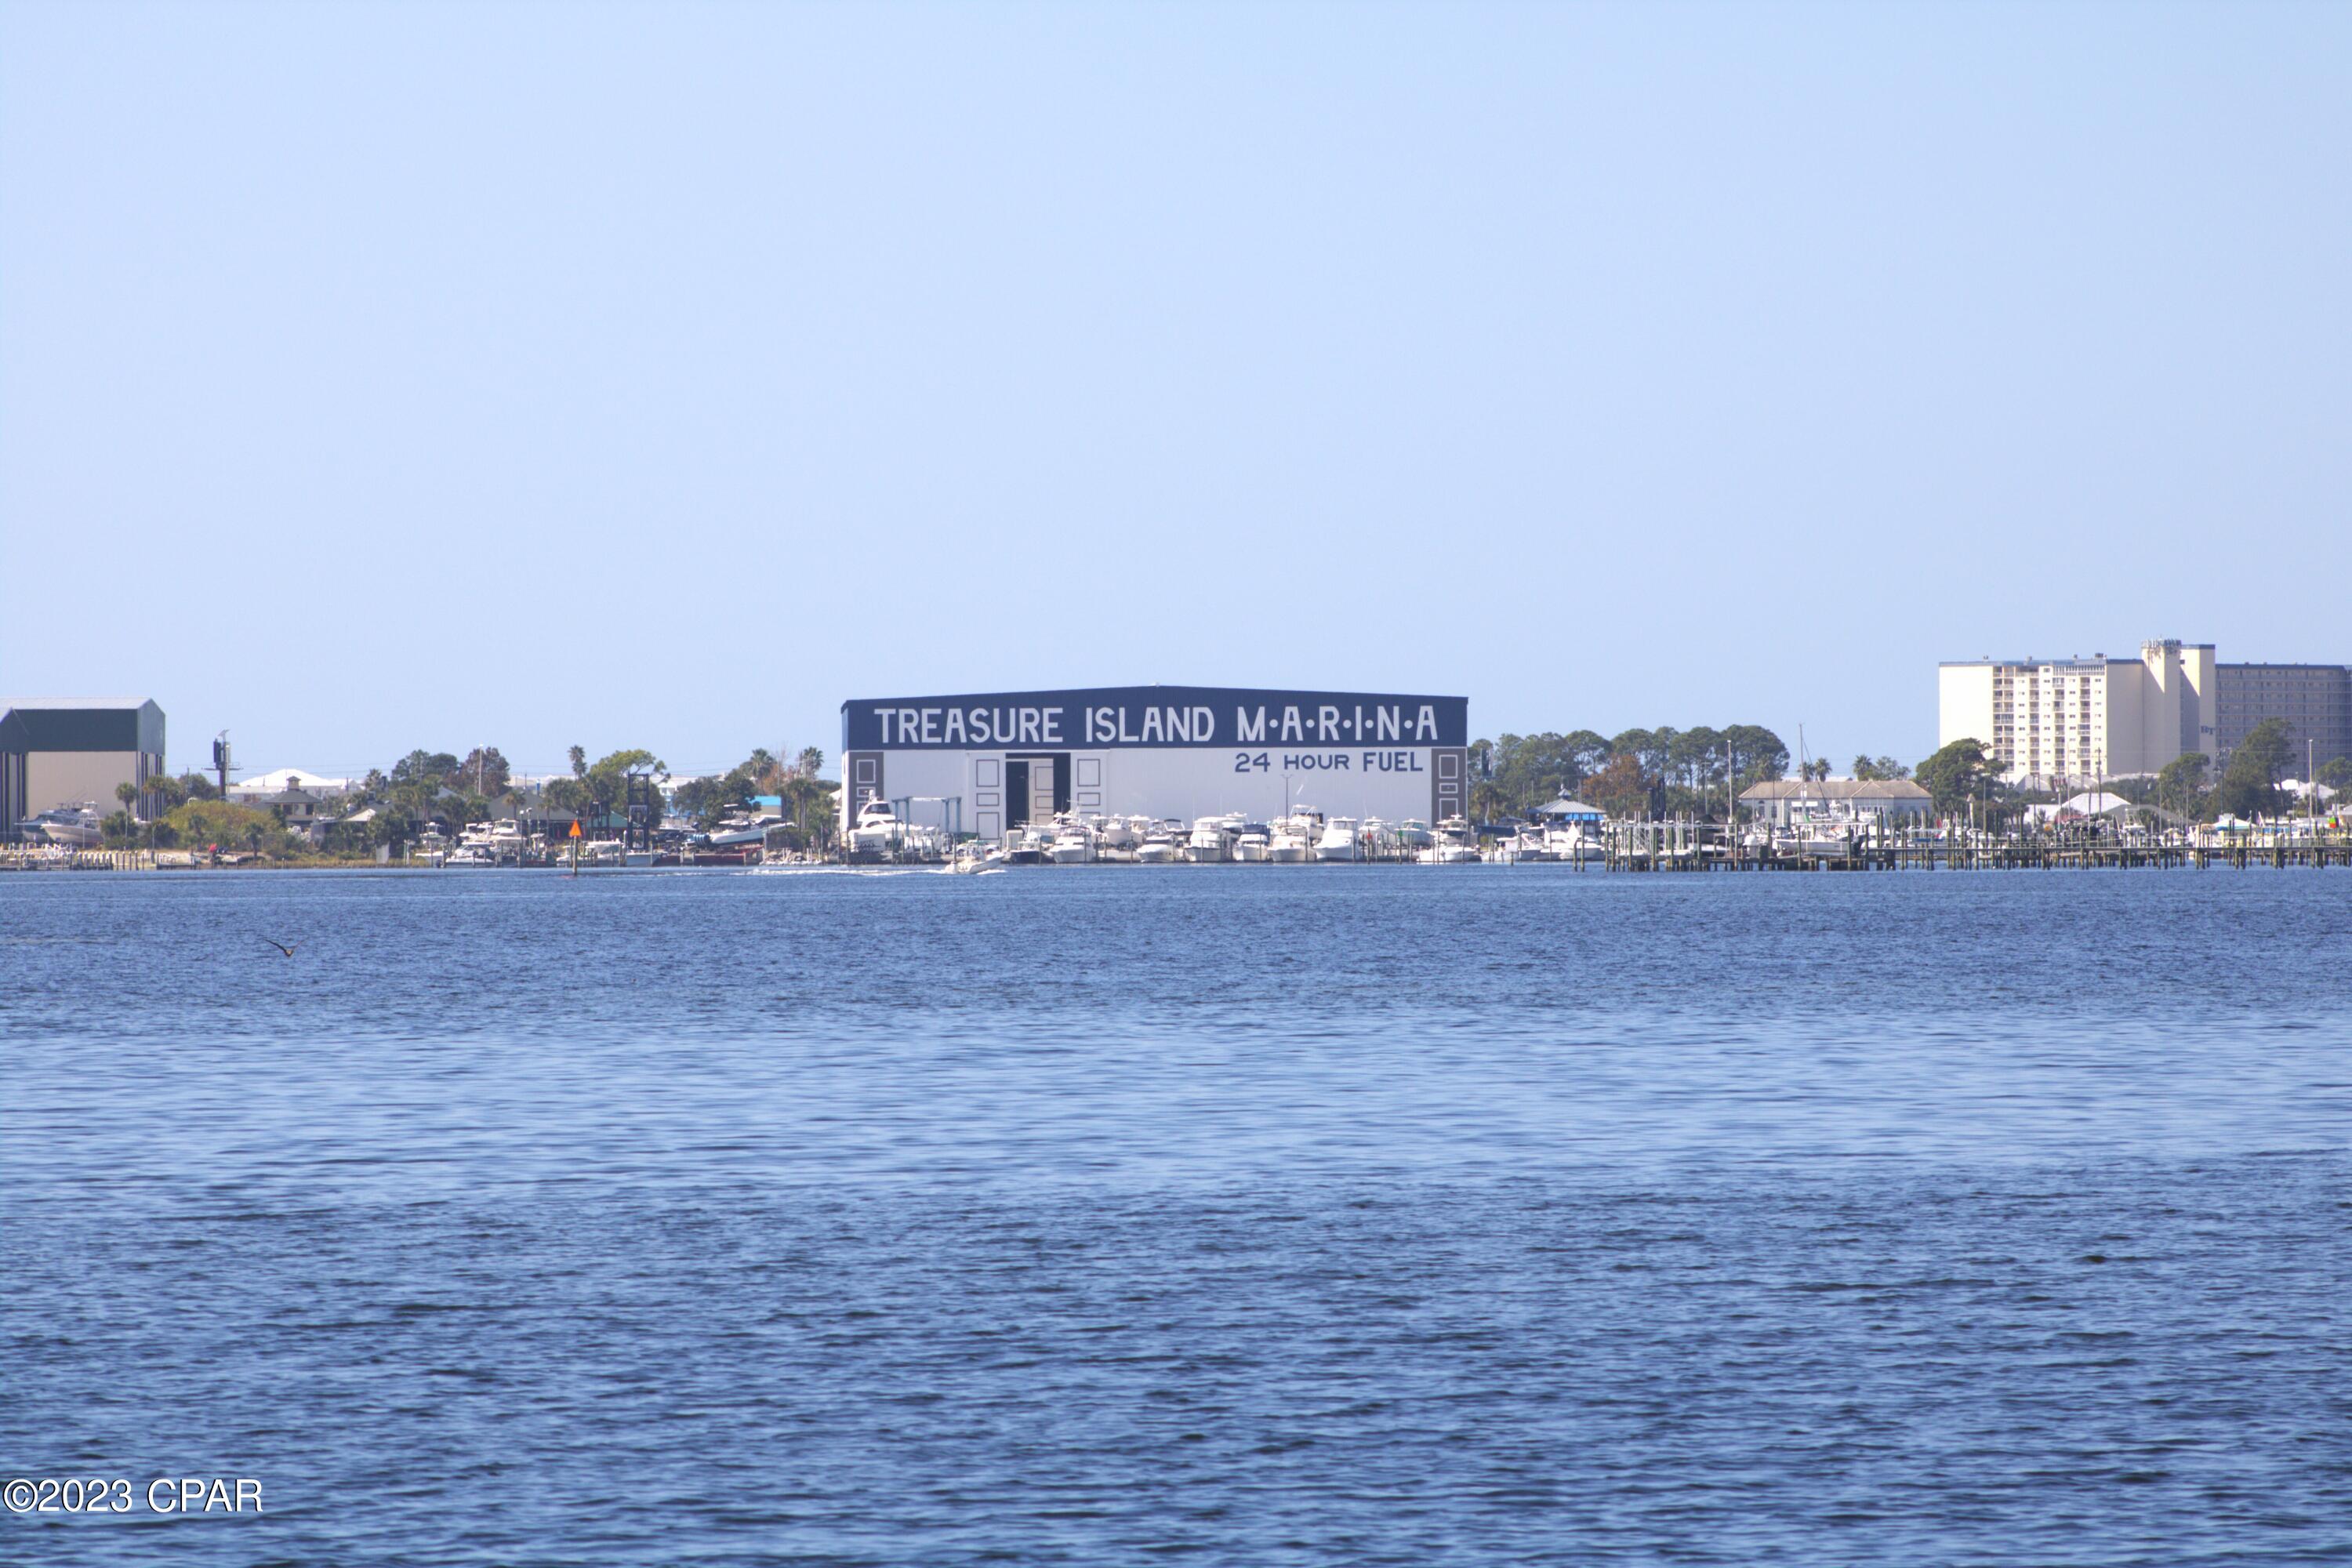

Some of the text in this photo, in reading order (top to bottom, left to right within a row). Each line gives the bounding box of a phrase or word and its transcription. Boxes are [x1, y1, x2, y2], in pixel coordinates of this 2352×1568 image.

[873, 706, 1063, 744] TREASURE
[1086, 706, 1215, 742] ISLAND
[1235, 751, 1424, 773] 24 HOUR FUEL
